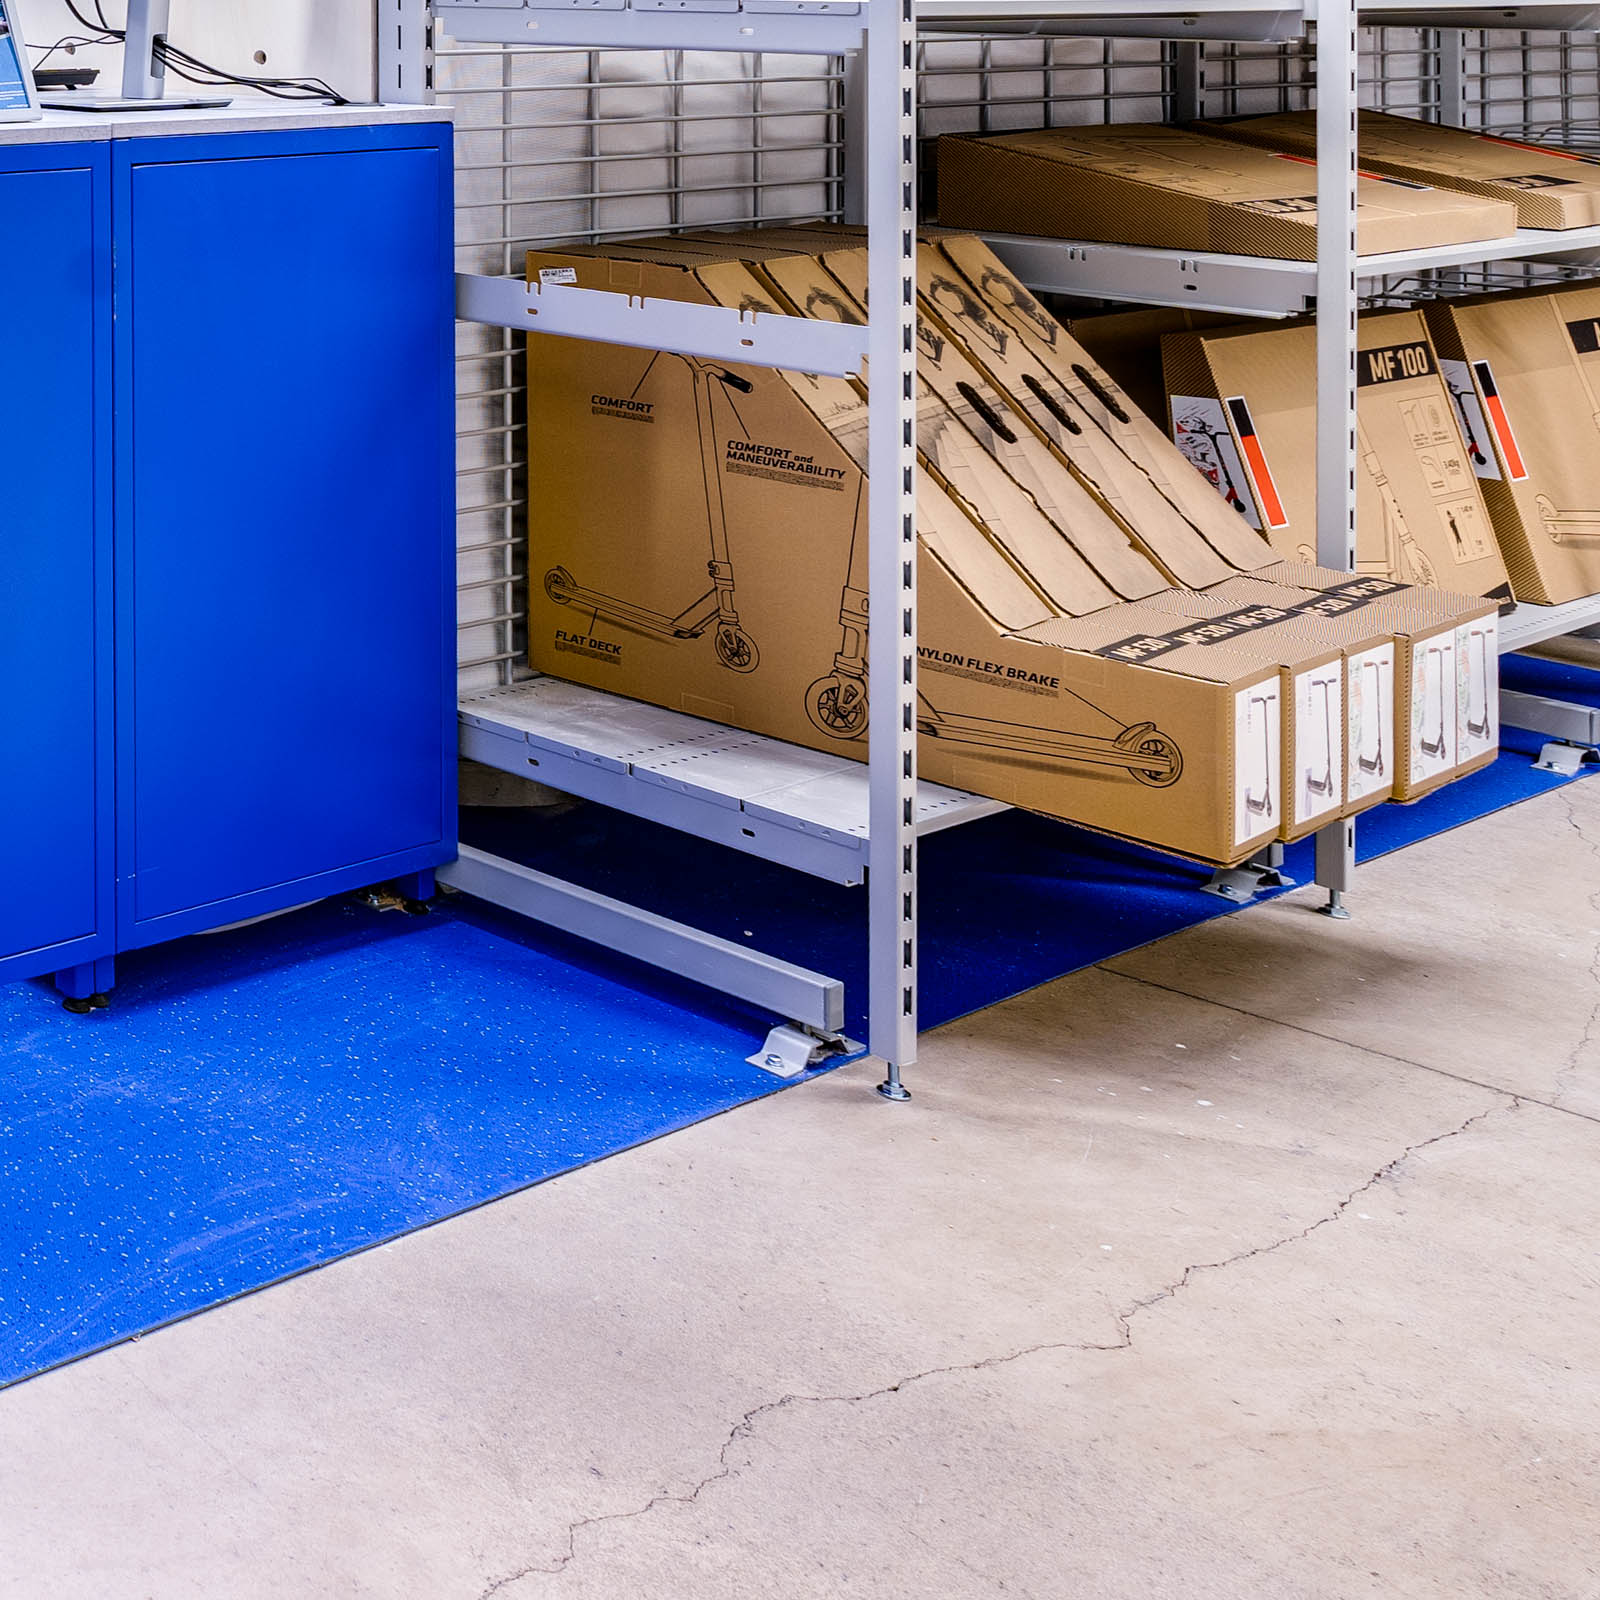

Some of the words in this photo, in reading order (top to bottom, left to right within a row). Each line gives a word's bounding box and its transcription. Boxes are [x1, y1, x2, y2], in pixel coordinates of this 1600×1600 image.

[1369, 350, 1395, 382] MF
[1399, 347, 1429, 377] 100
[591, 394, 654, 414] COMFORT
[727, 439, 792, 460] COMFORT
[794, 453, 813, 463] and
[726, 450, 846, 480] MANEUVERABILITY
[556, 630, 587, 645] FLAT
[589, 639, 622, 655] DECK
[917, 646, 963, 666] NYLON
[967, 658, 1004, 676] FLEX
[1006, 667, 1060, 689] BRAKE
